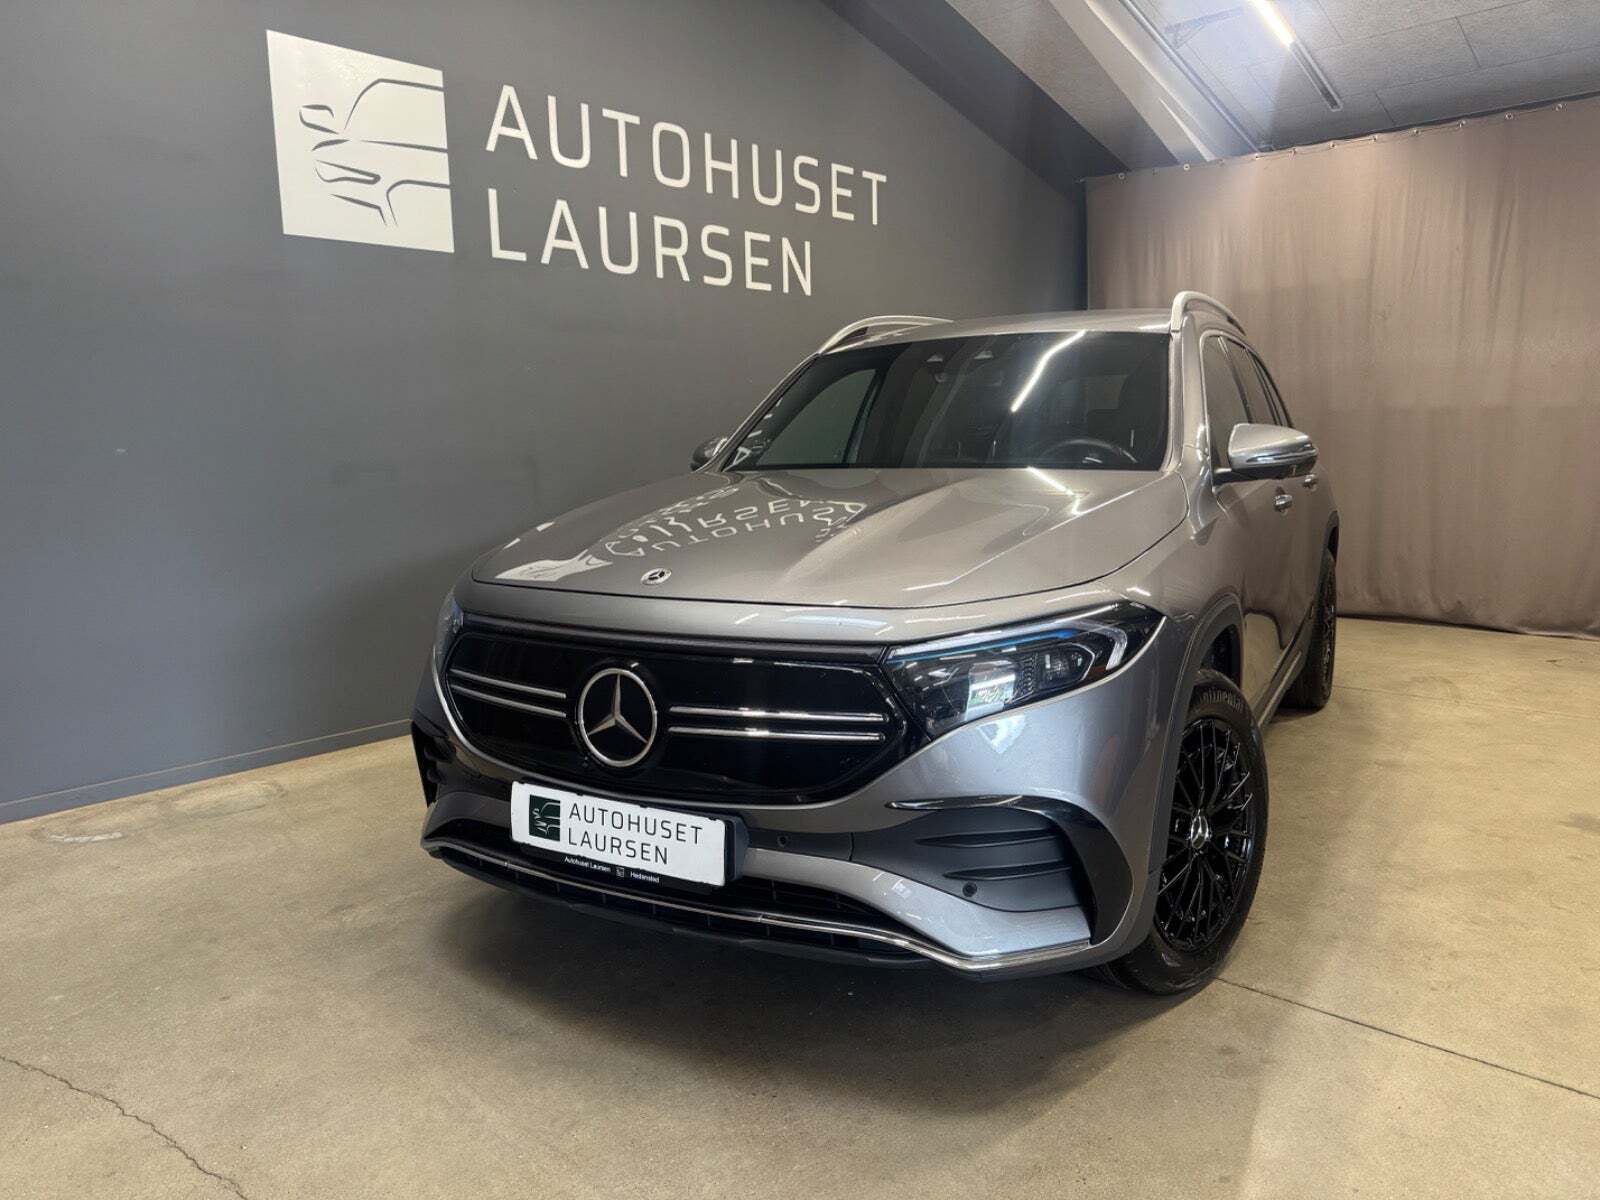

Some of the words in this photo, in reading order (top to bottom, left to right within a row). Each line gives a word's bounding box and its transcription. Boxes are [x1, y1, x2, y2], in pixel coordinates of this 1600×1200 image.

[486, 84, 887, 225] AUTOHUSET
[487, 188, 812, 296] LAURSEN
[569, 803, 703, 844] AUTOHUSET
[564, 857, 589, 868] Autohuset
[590, 861, 611, 873] Laursen
[568, 827, 668, 864] LAURSEN
